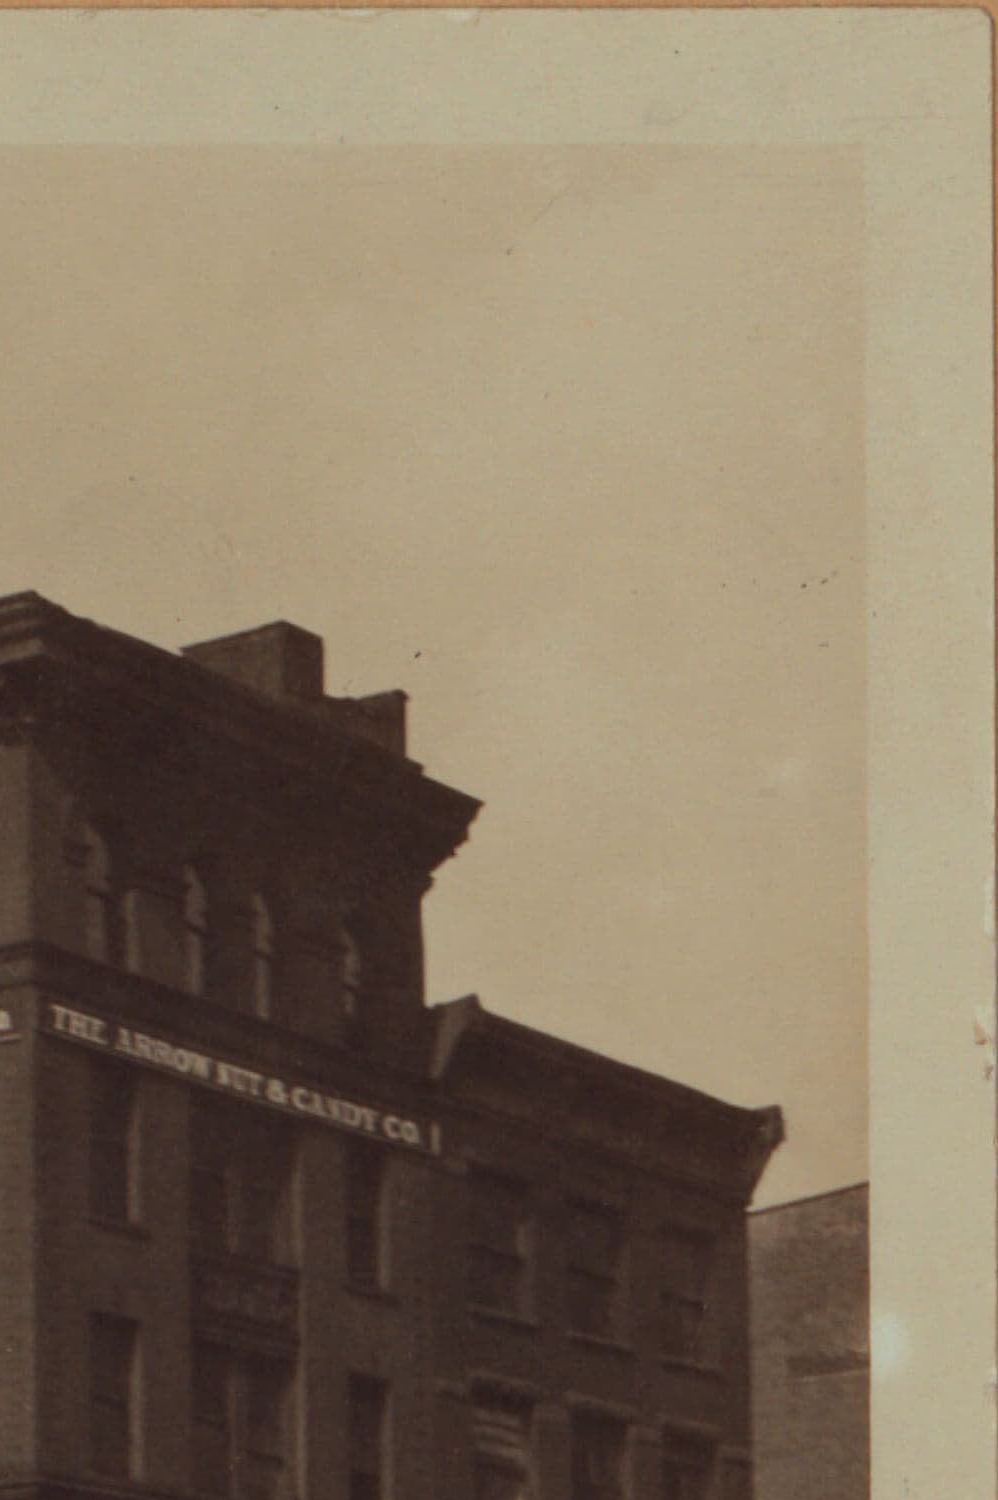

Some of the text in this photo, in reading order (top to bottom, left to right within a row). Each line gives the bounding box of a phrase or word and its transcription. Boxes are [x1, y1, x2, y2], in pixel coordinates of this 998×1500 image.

[50, 1004, 108, 1046] THE
[114, 1027, 209, 1078] ARROW
[217, 1062, 264, 1096] NUT
[265, 1077, 289, 1105] &
[291, 1087, 380, 1131] CANDY
